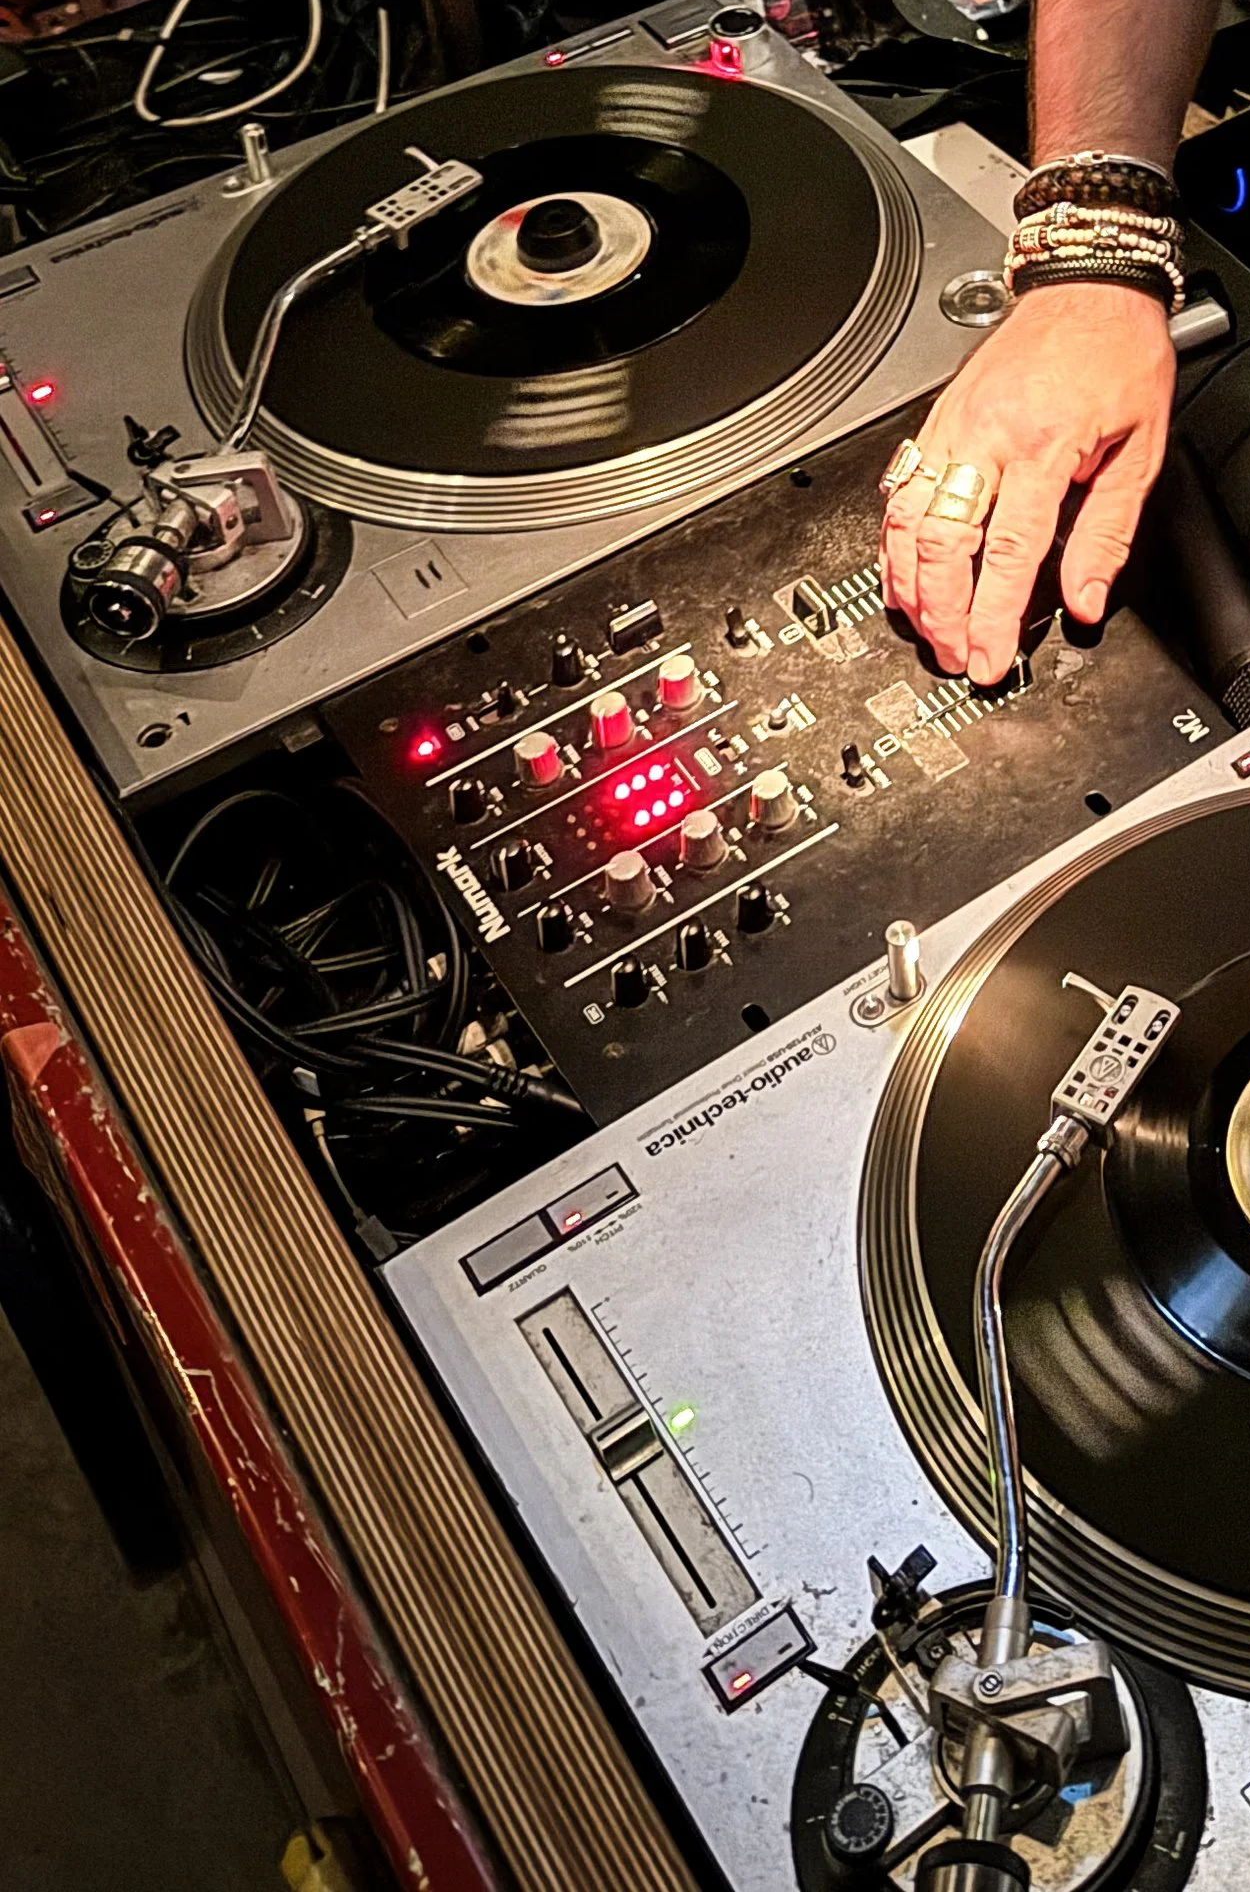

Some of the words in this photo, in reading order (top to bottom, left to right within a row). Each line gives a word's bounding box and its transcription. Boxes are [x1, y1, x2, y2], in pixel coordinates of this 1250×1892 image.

[1171, 708, 1211, 745] M2
[430, 843, 512, 946] Numark
[842, 977, 867, 996] LIGHT
[643, 1045, 817, 1163] audio-technica
[593, 1223, 625, 1246] PITCH
[506, 1263, 548, 1293] QUARTZ
[710, 1605, 772, 1651] DIRECTION
